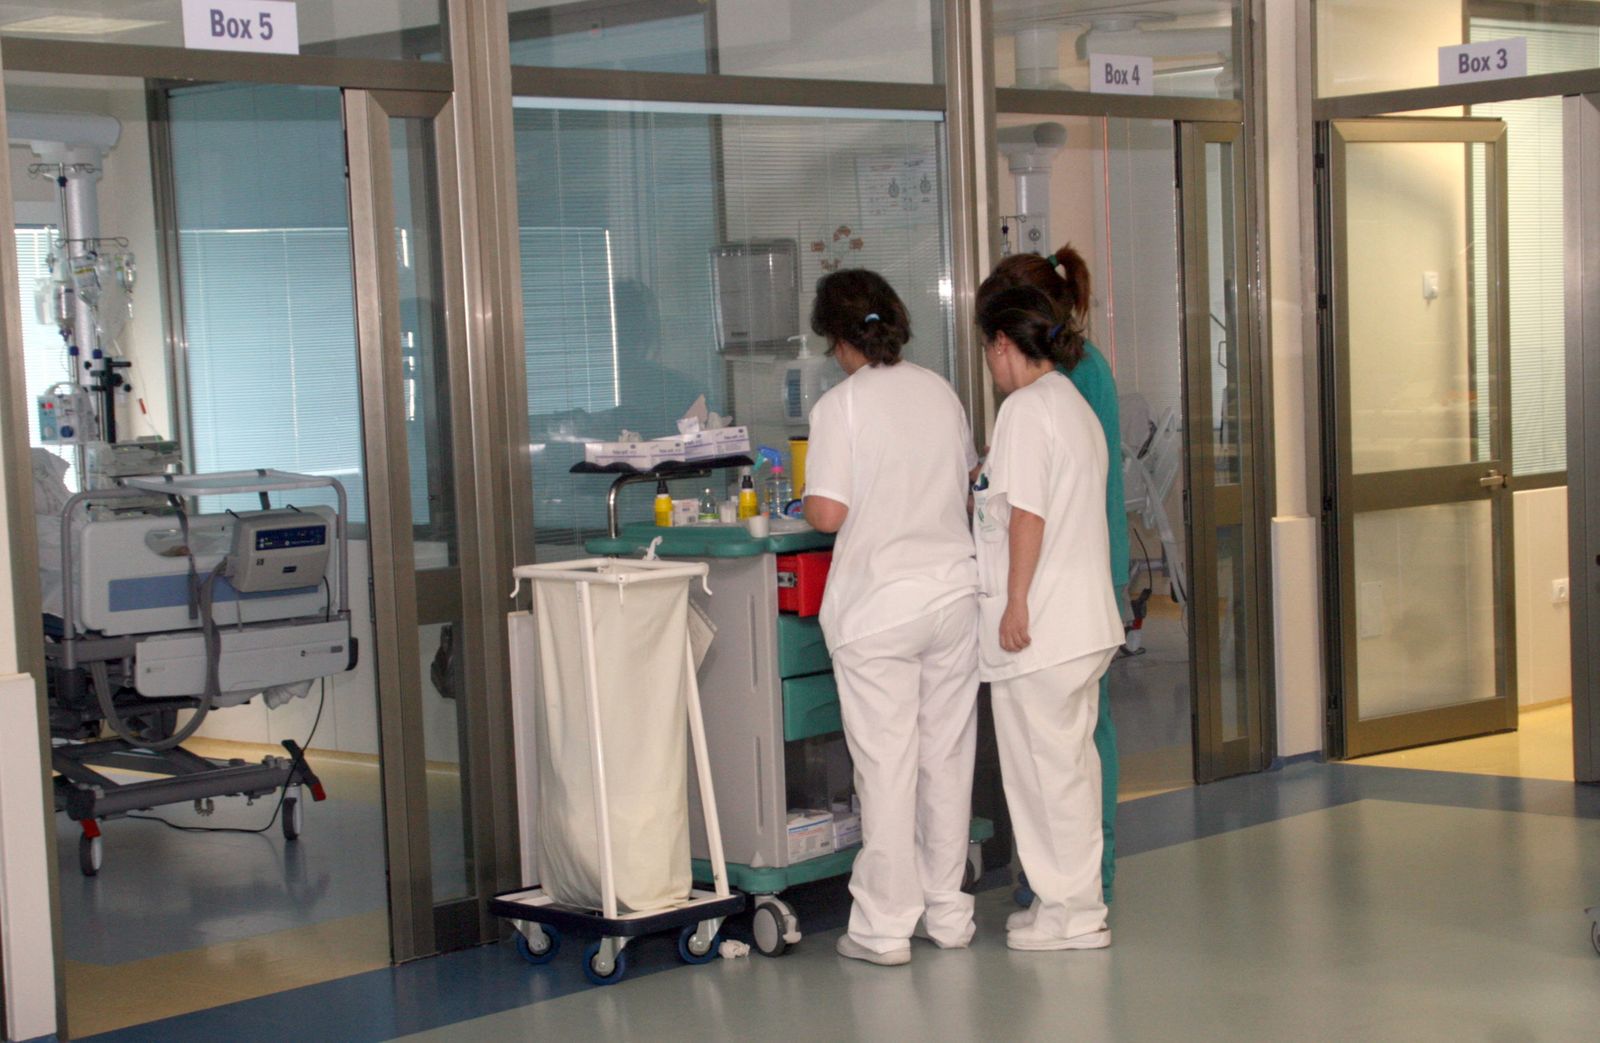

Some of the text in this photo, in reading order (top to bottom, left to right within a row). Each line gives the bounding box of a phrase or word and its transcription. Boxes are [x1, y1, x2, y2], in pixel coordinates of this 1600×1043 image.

[210, 9, 273, 41] Box 5
[1459, 48, 1508, 74] Box 3
[1105, 63, 1140, 86] Box 4
